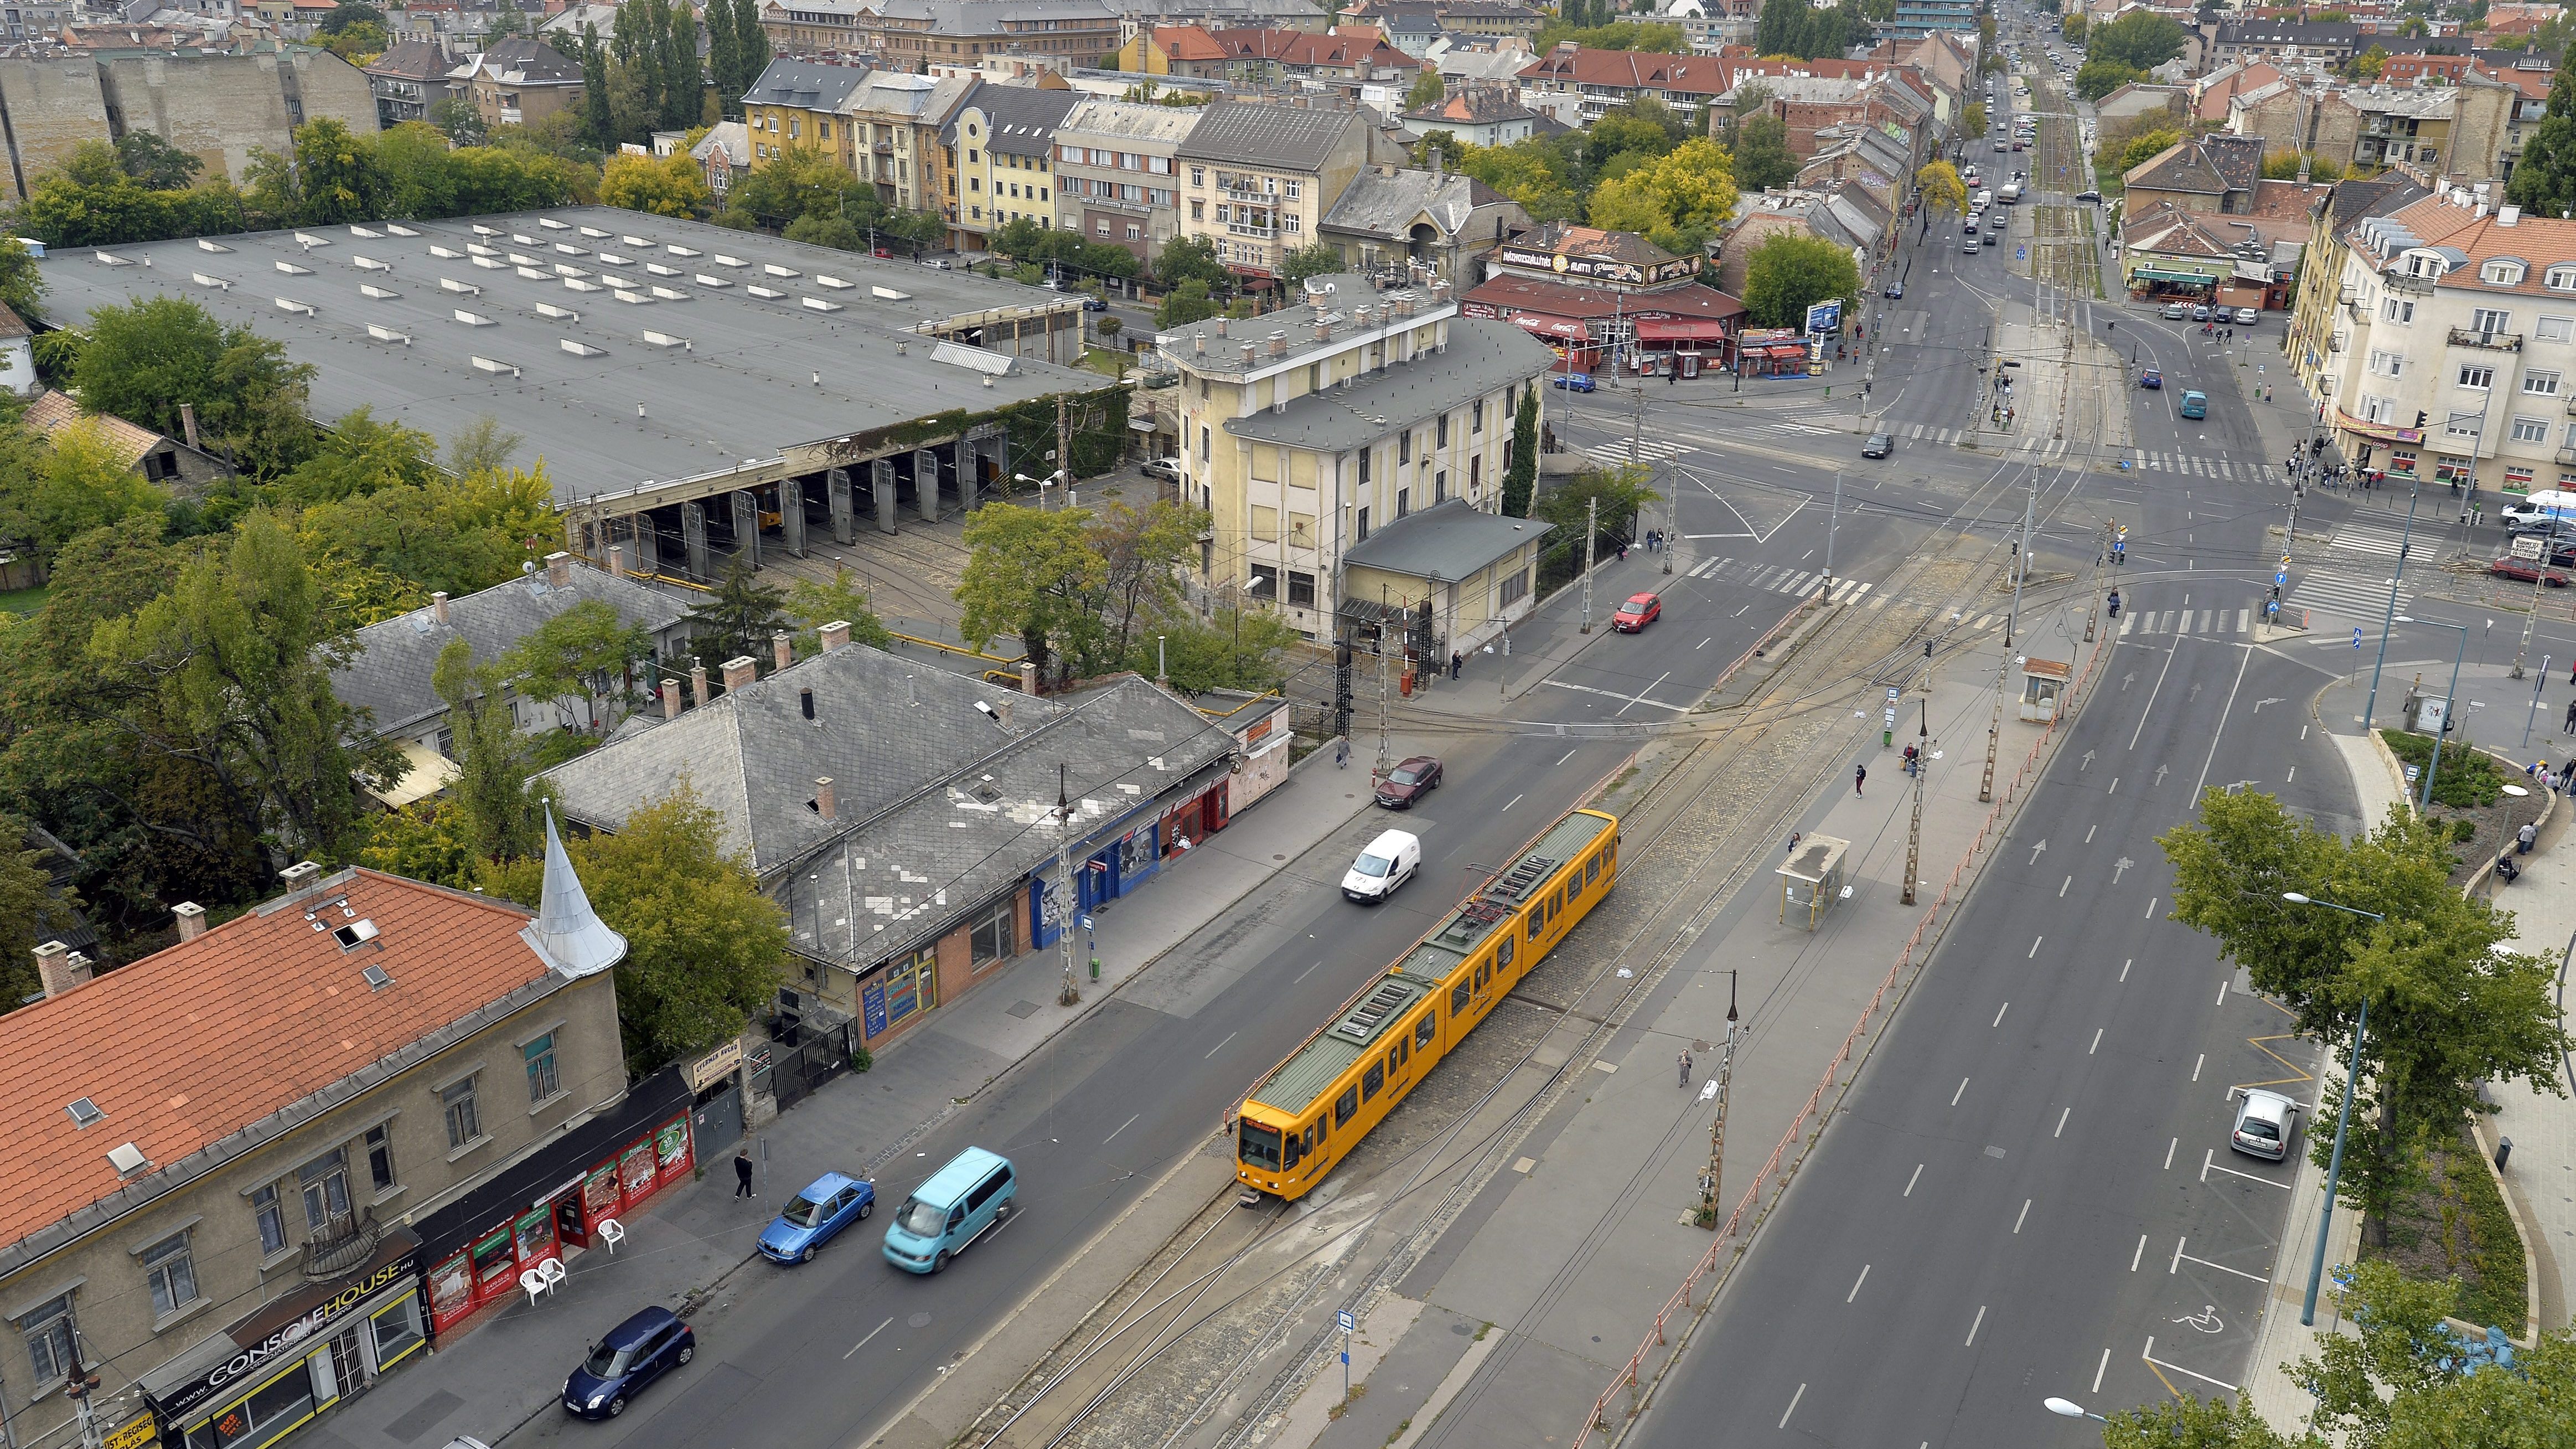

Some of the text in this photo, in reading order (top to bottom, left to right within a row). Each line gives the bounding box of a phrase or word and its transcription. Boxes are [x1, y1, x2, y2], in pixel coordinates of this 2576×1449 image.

[1570, 261, 1591, 273] ALATTI
[664, 1123, 677, 1133] Pizza
[629, 1144, 643, 1156] Pizza
